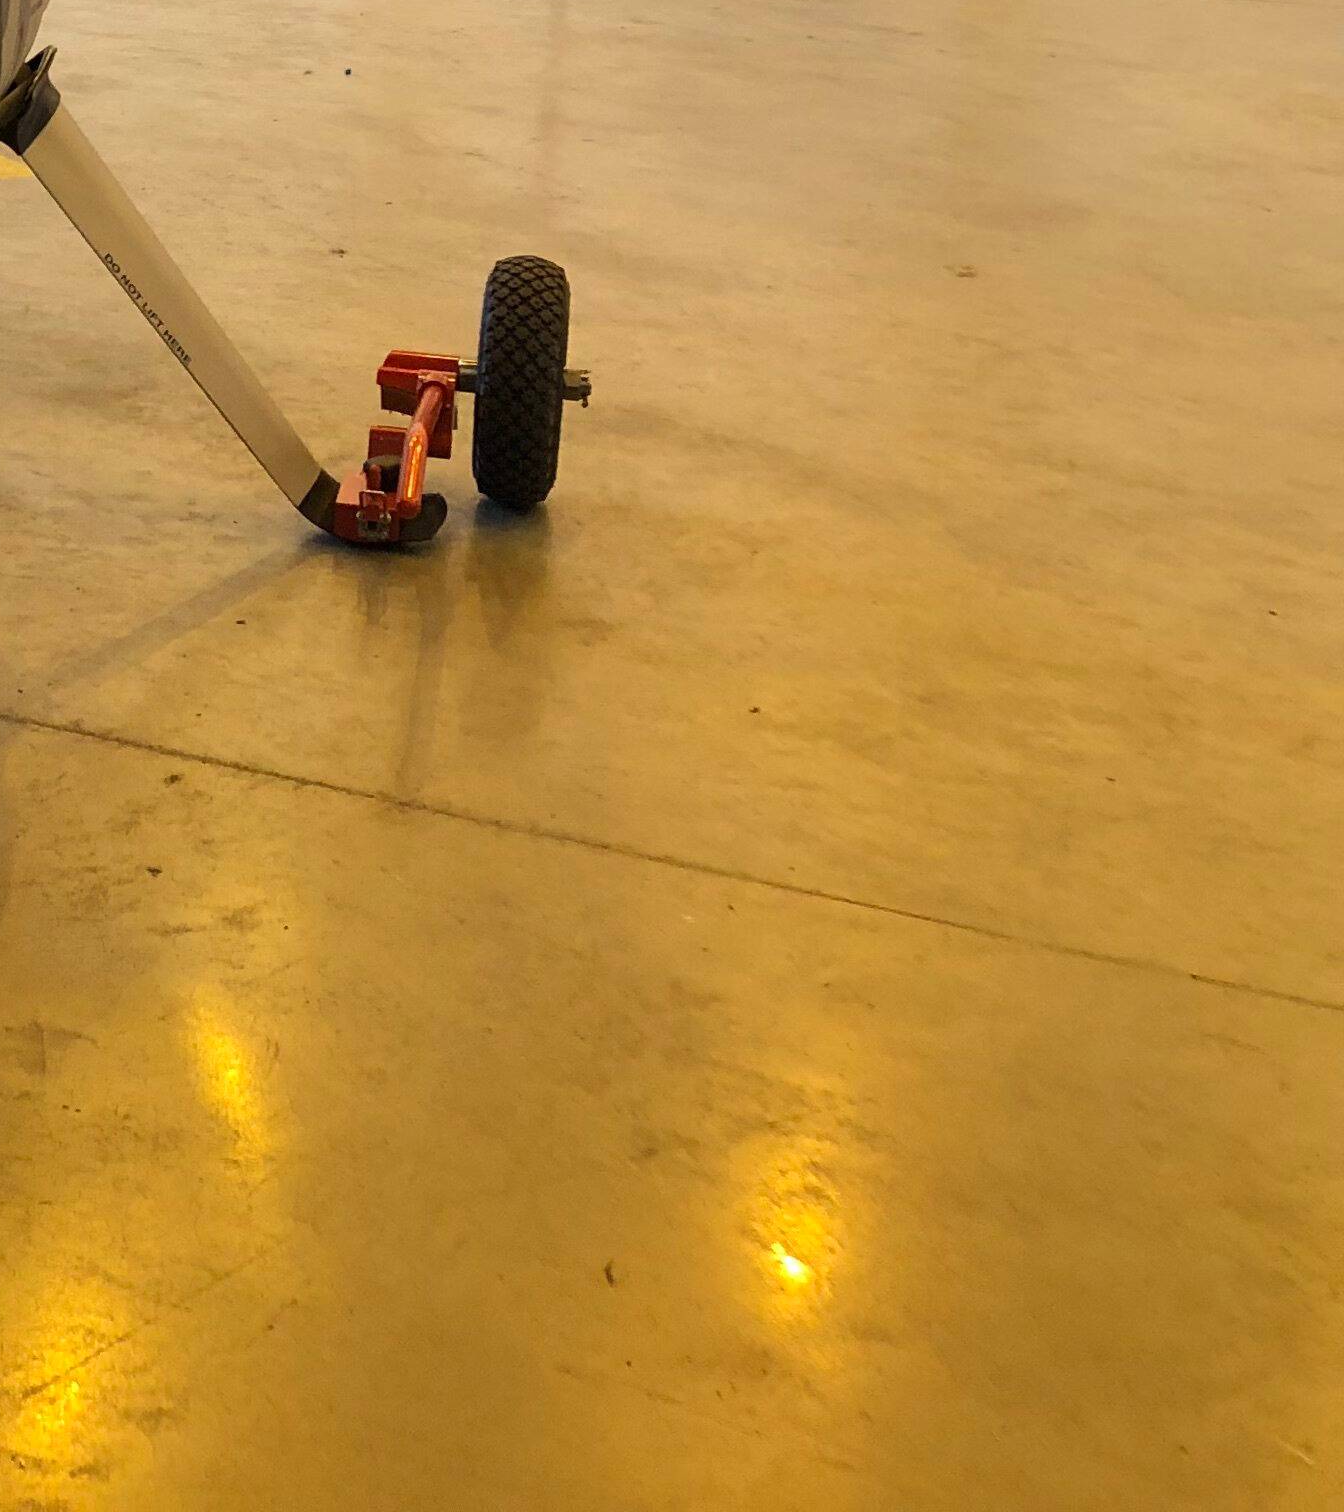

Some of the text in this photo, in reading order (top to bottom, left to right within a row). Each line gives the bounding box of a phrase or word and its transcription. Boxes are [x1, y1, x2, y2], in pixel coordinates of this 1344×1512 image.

[104, 253, 192, 364] DO NOT LIFT HERE
